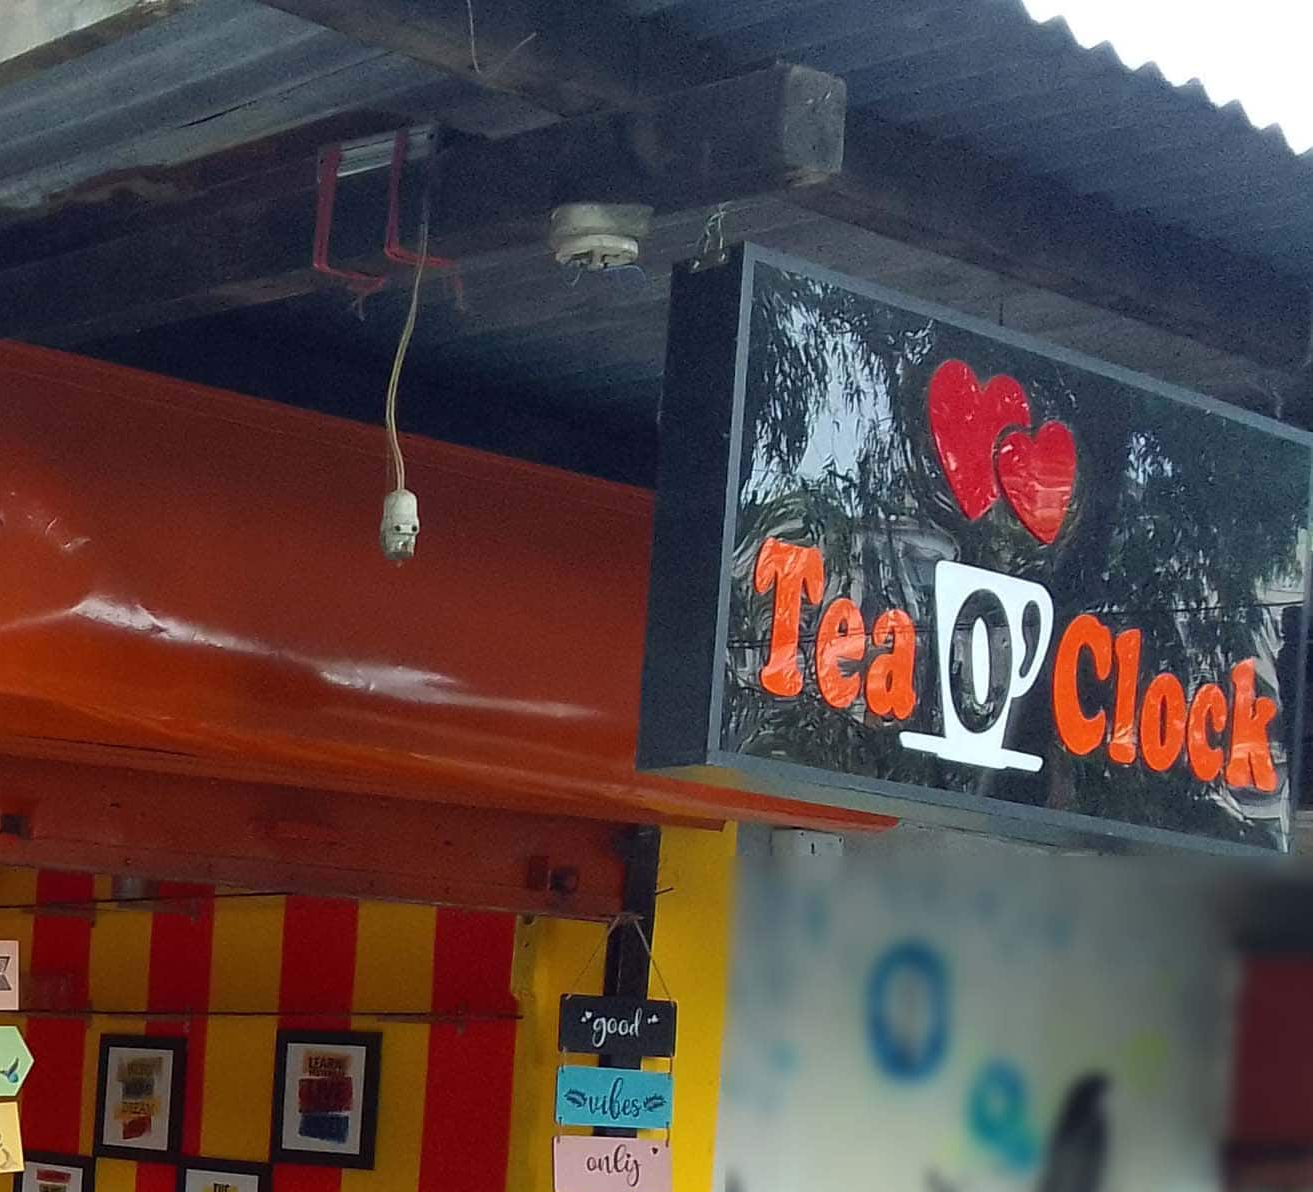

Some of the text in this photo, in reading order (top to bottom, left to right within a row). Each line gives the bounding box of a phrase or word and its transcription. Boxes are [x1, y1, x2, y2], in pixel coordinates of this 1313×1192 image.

[753, 536, 917, 721] Tea
[1052, 613, 1279, 793] Clock
[591, 1007, 643, 1048] good
[587, 1076, 641, 1120] vibes
[586, 1143, 643, 1188] only
